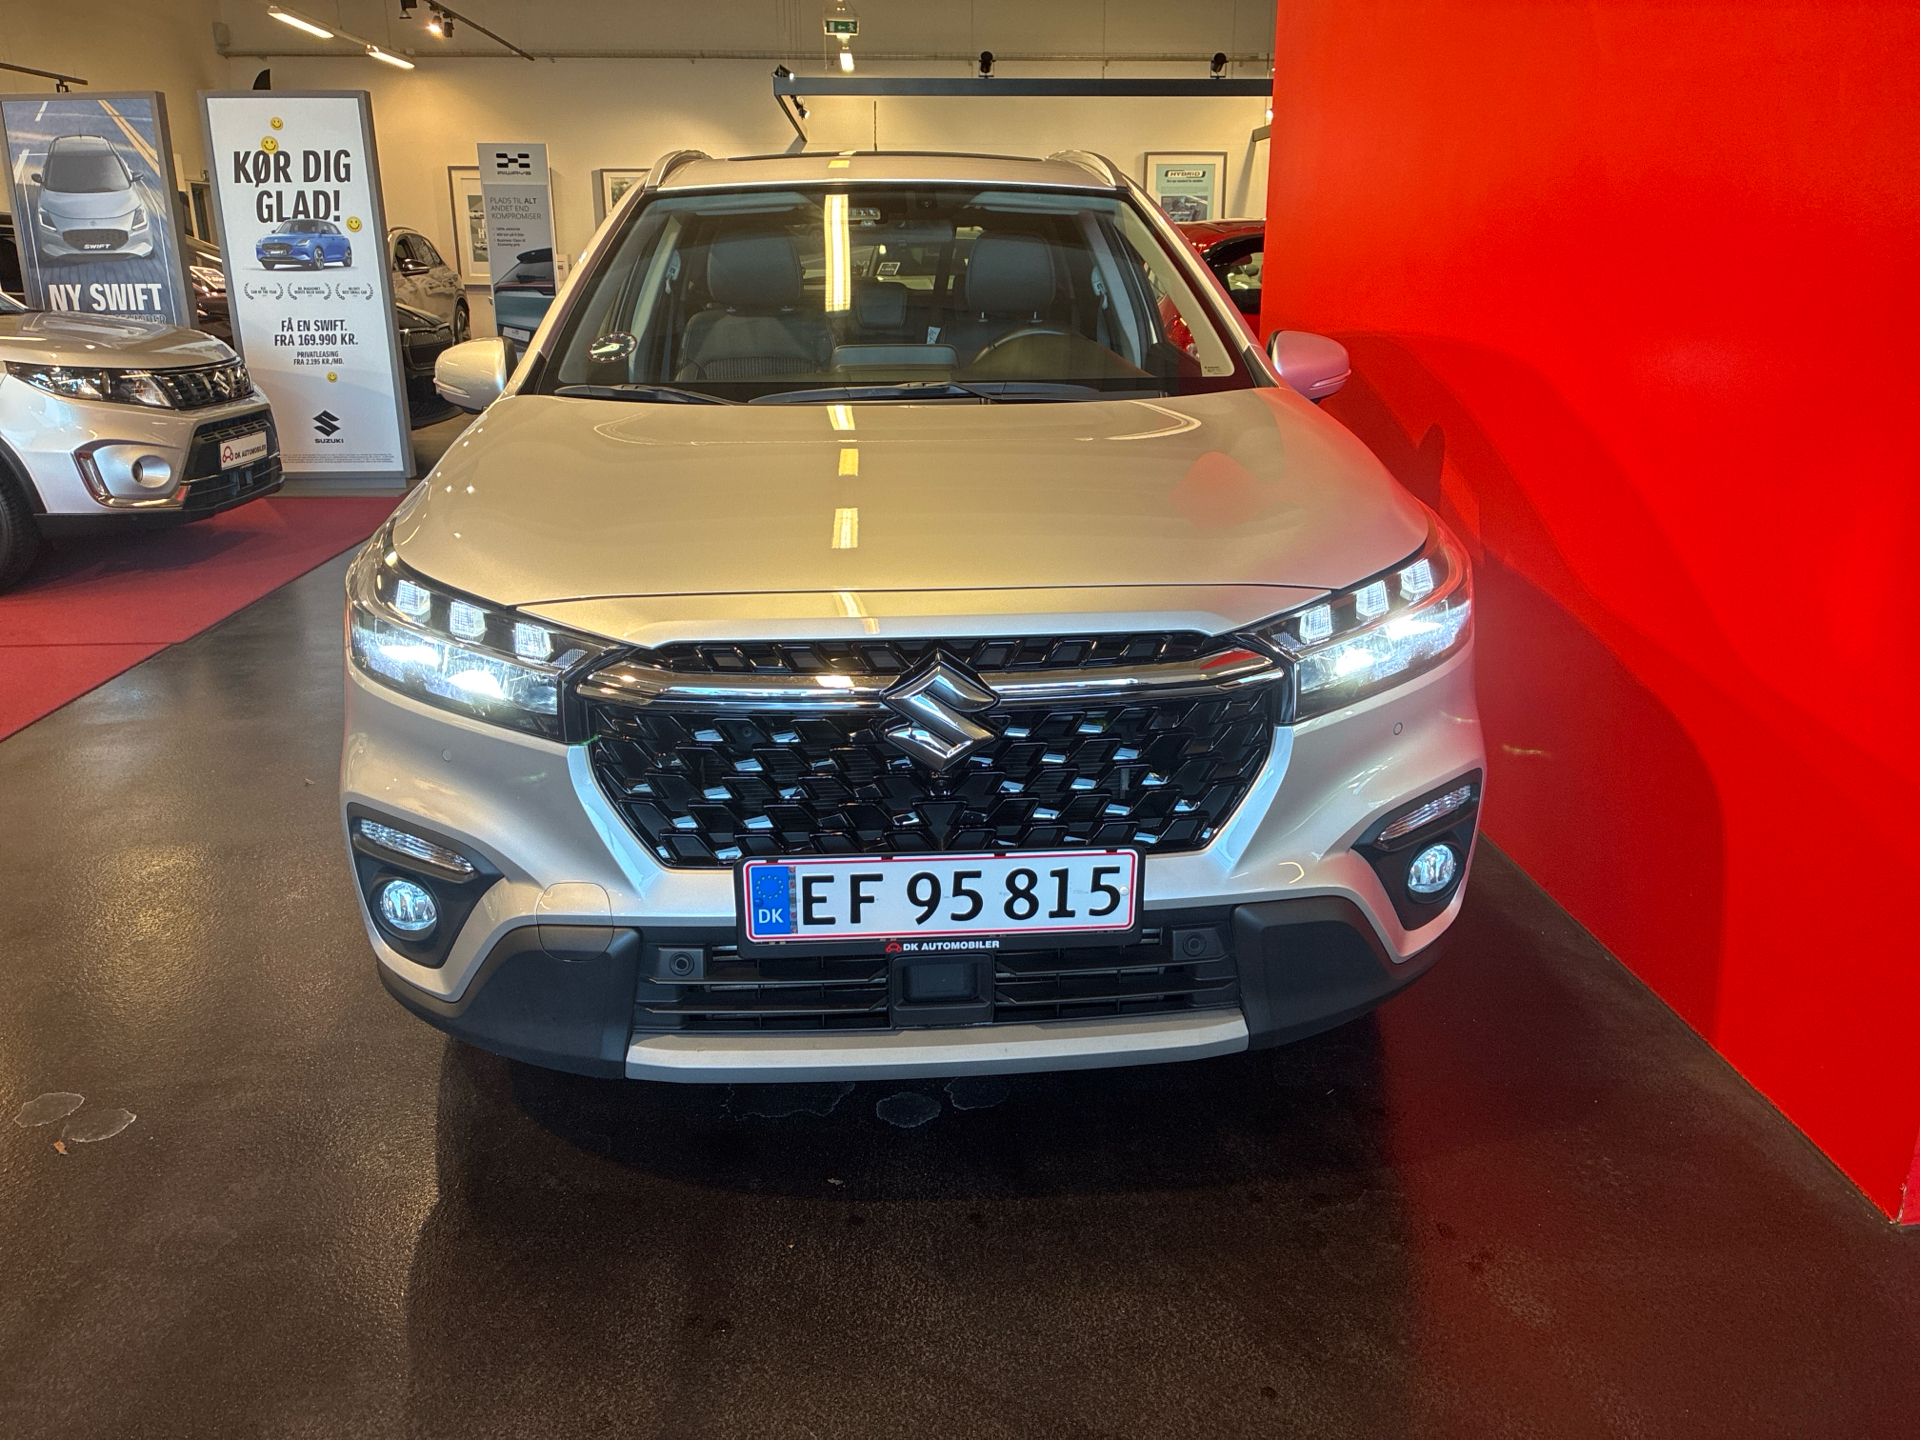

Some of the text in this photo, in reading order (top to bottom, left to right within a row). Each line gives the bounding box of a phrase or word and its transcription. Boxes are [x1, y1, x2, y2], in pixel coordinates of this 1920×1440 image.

[233, 149, 351, 188] KØR DIG
[256, 190, 341, 223] GLAD!
[490, 197, 512, 205] PLADS
[48, 284, 162, 311] NY SWIFT
[281, 316, 348, 332] FÅ EN SWIFT.
[274, 333, 358, 346] FRA 169.990 KR.
[802, 866, 1121, 926] EF 95 815
[758, 908, 784, 924] DK
[903, 940, 1000, 951] DK AUTOMOBILER
